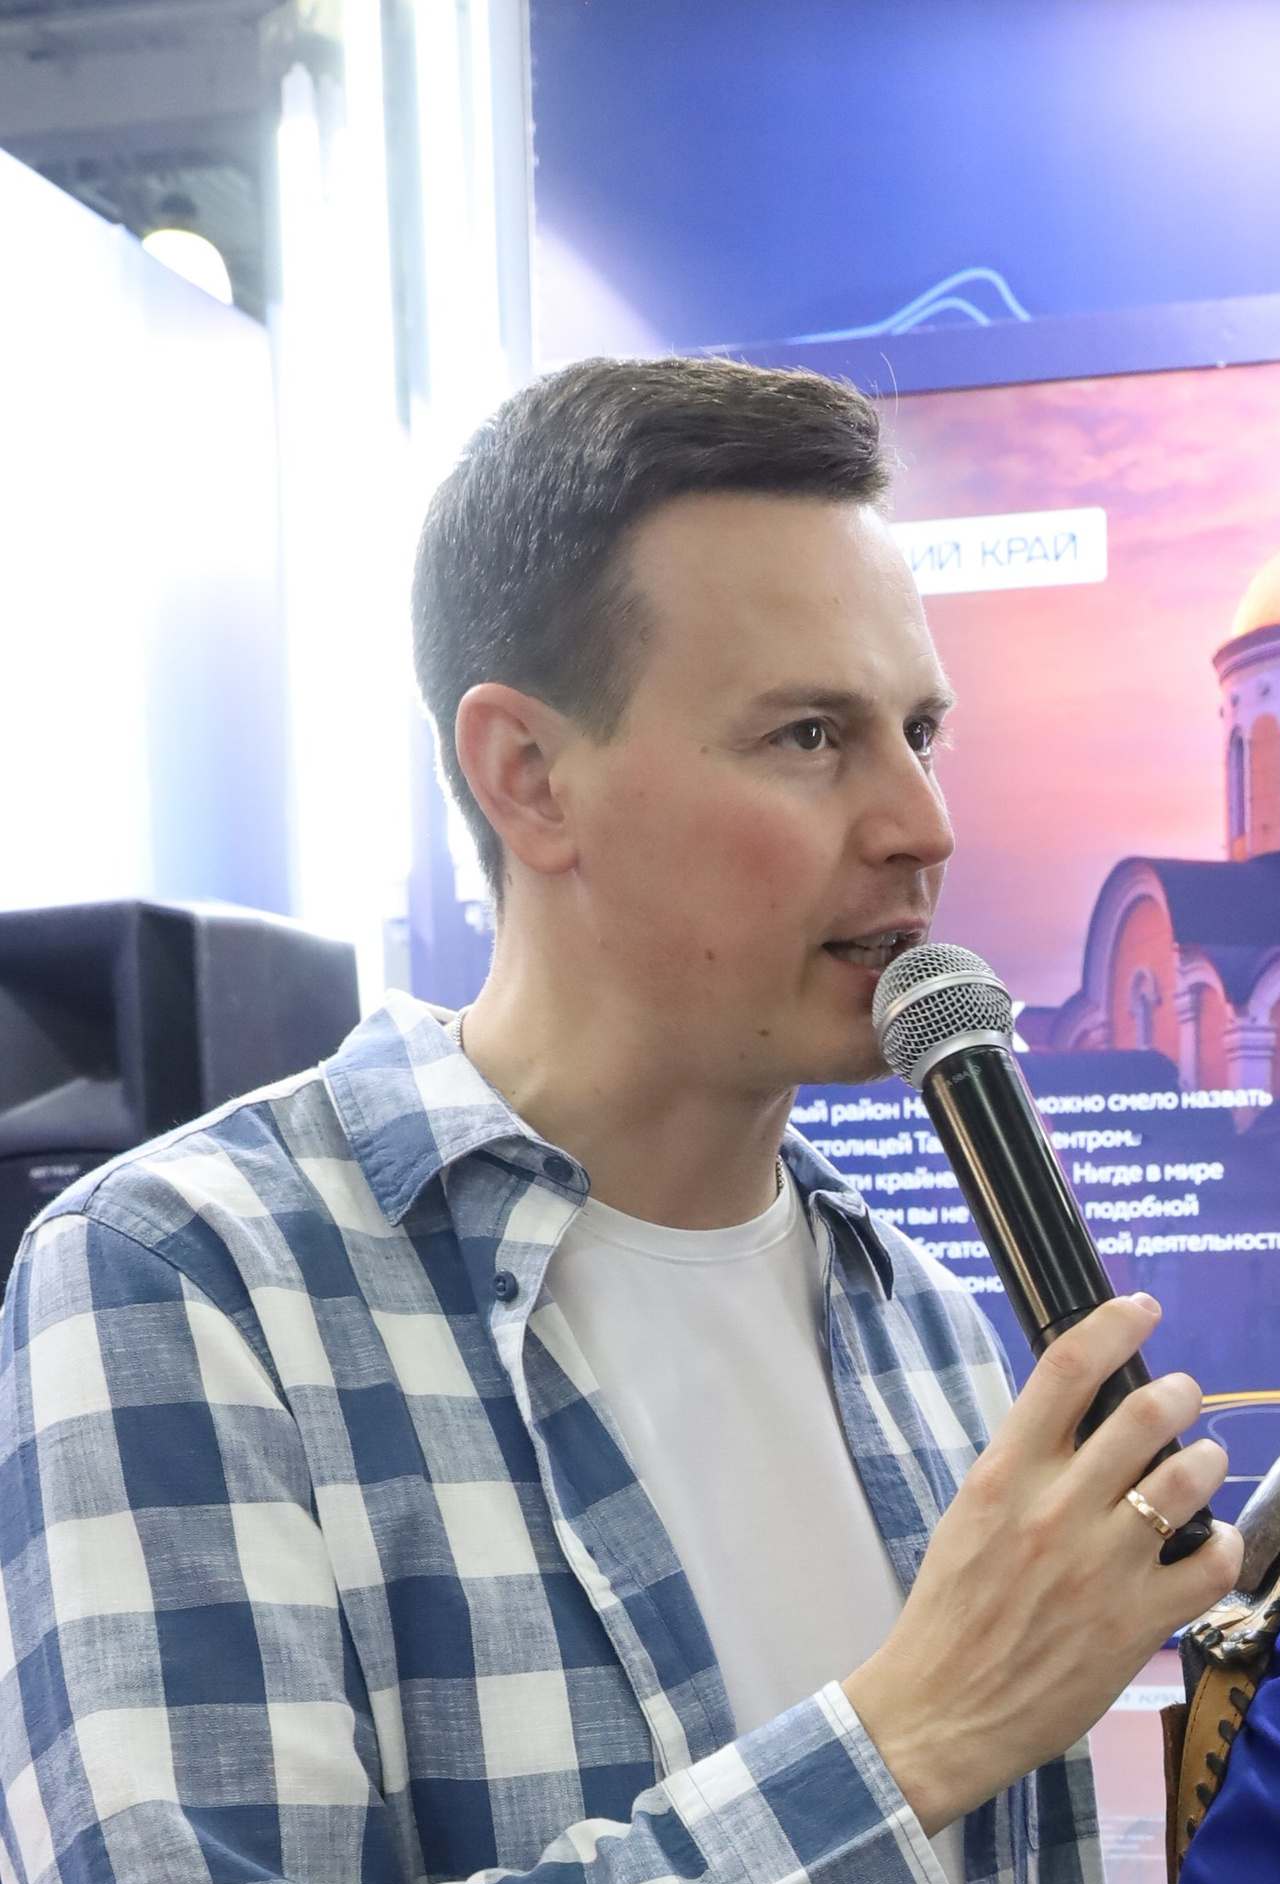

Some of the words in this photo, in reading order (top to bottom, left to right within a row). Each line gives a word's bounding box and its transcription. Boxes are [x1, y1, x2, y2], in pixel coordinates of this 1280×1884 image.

[903, 541, 962, 572] ИЙ
[980, 533, 1078, 567] КРАЙ
[789, 1100, 828, 1124] ый
[831, 1097, 900, 1127] район
[1108, 1091, 1178, 1112] смело
[1181, 1089, 1273, 1109] назвать
[875, 1166, 959, 1195] крайне
[1073, 1161, 1143, 1186] Нигде
[1145, 1164, 1161, 1182] в
[1164, 1162, 1224, 1185] мире
[907, 1207, 938, 1225] вы
[941, 1206, 969, 1224] не
[1085, 1193, 1199, 1222] подобной
